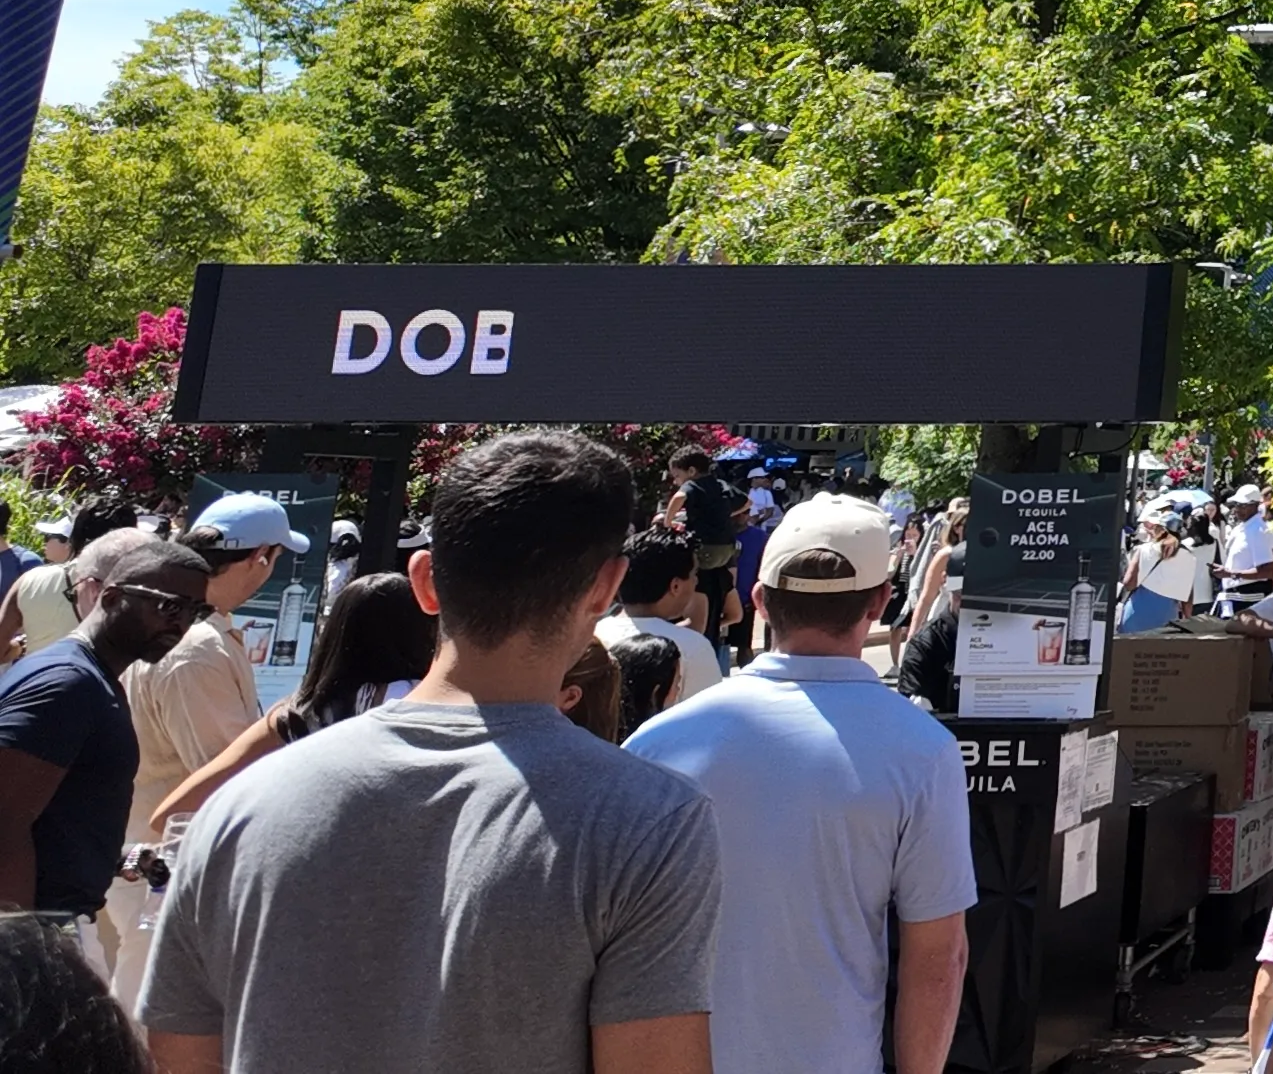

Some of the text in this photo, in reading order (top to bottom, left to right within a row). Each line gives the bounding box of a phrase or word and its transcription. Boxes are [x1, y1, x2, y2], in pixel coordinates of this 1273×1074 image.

[331, 309, 514, 376] DOB
[223, 490, 305, 505] BEL
[1002, 488, 1085, 504] DOBEL
[1018, 508, 1067, 517] TEQUILA
[1026, 521, 1055, 533] ACE
[1010, 534, 1069, 546] PALOMA
[1022, 550, 1055, 561] 22.00
